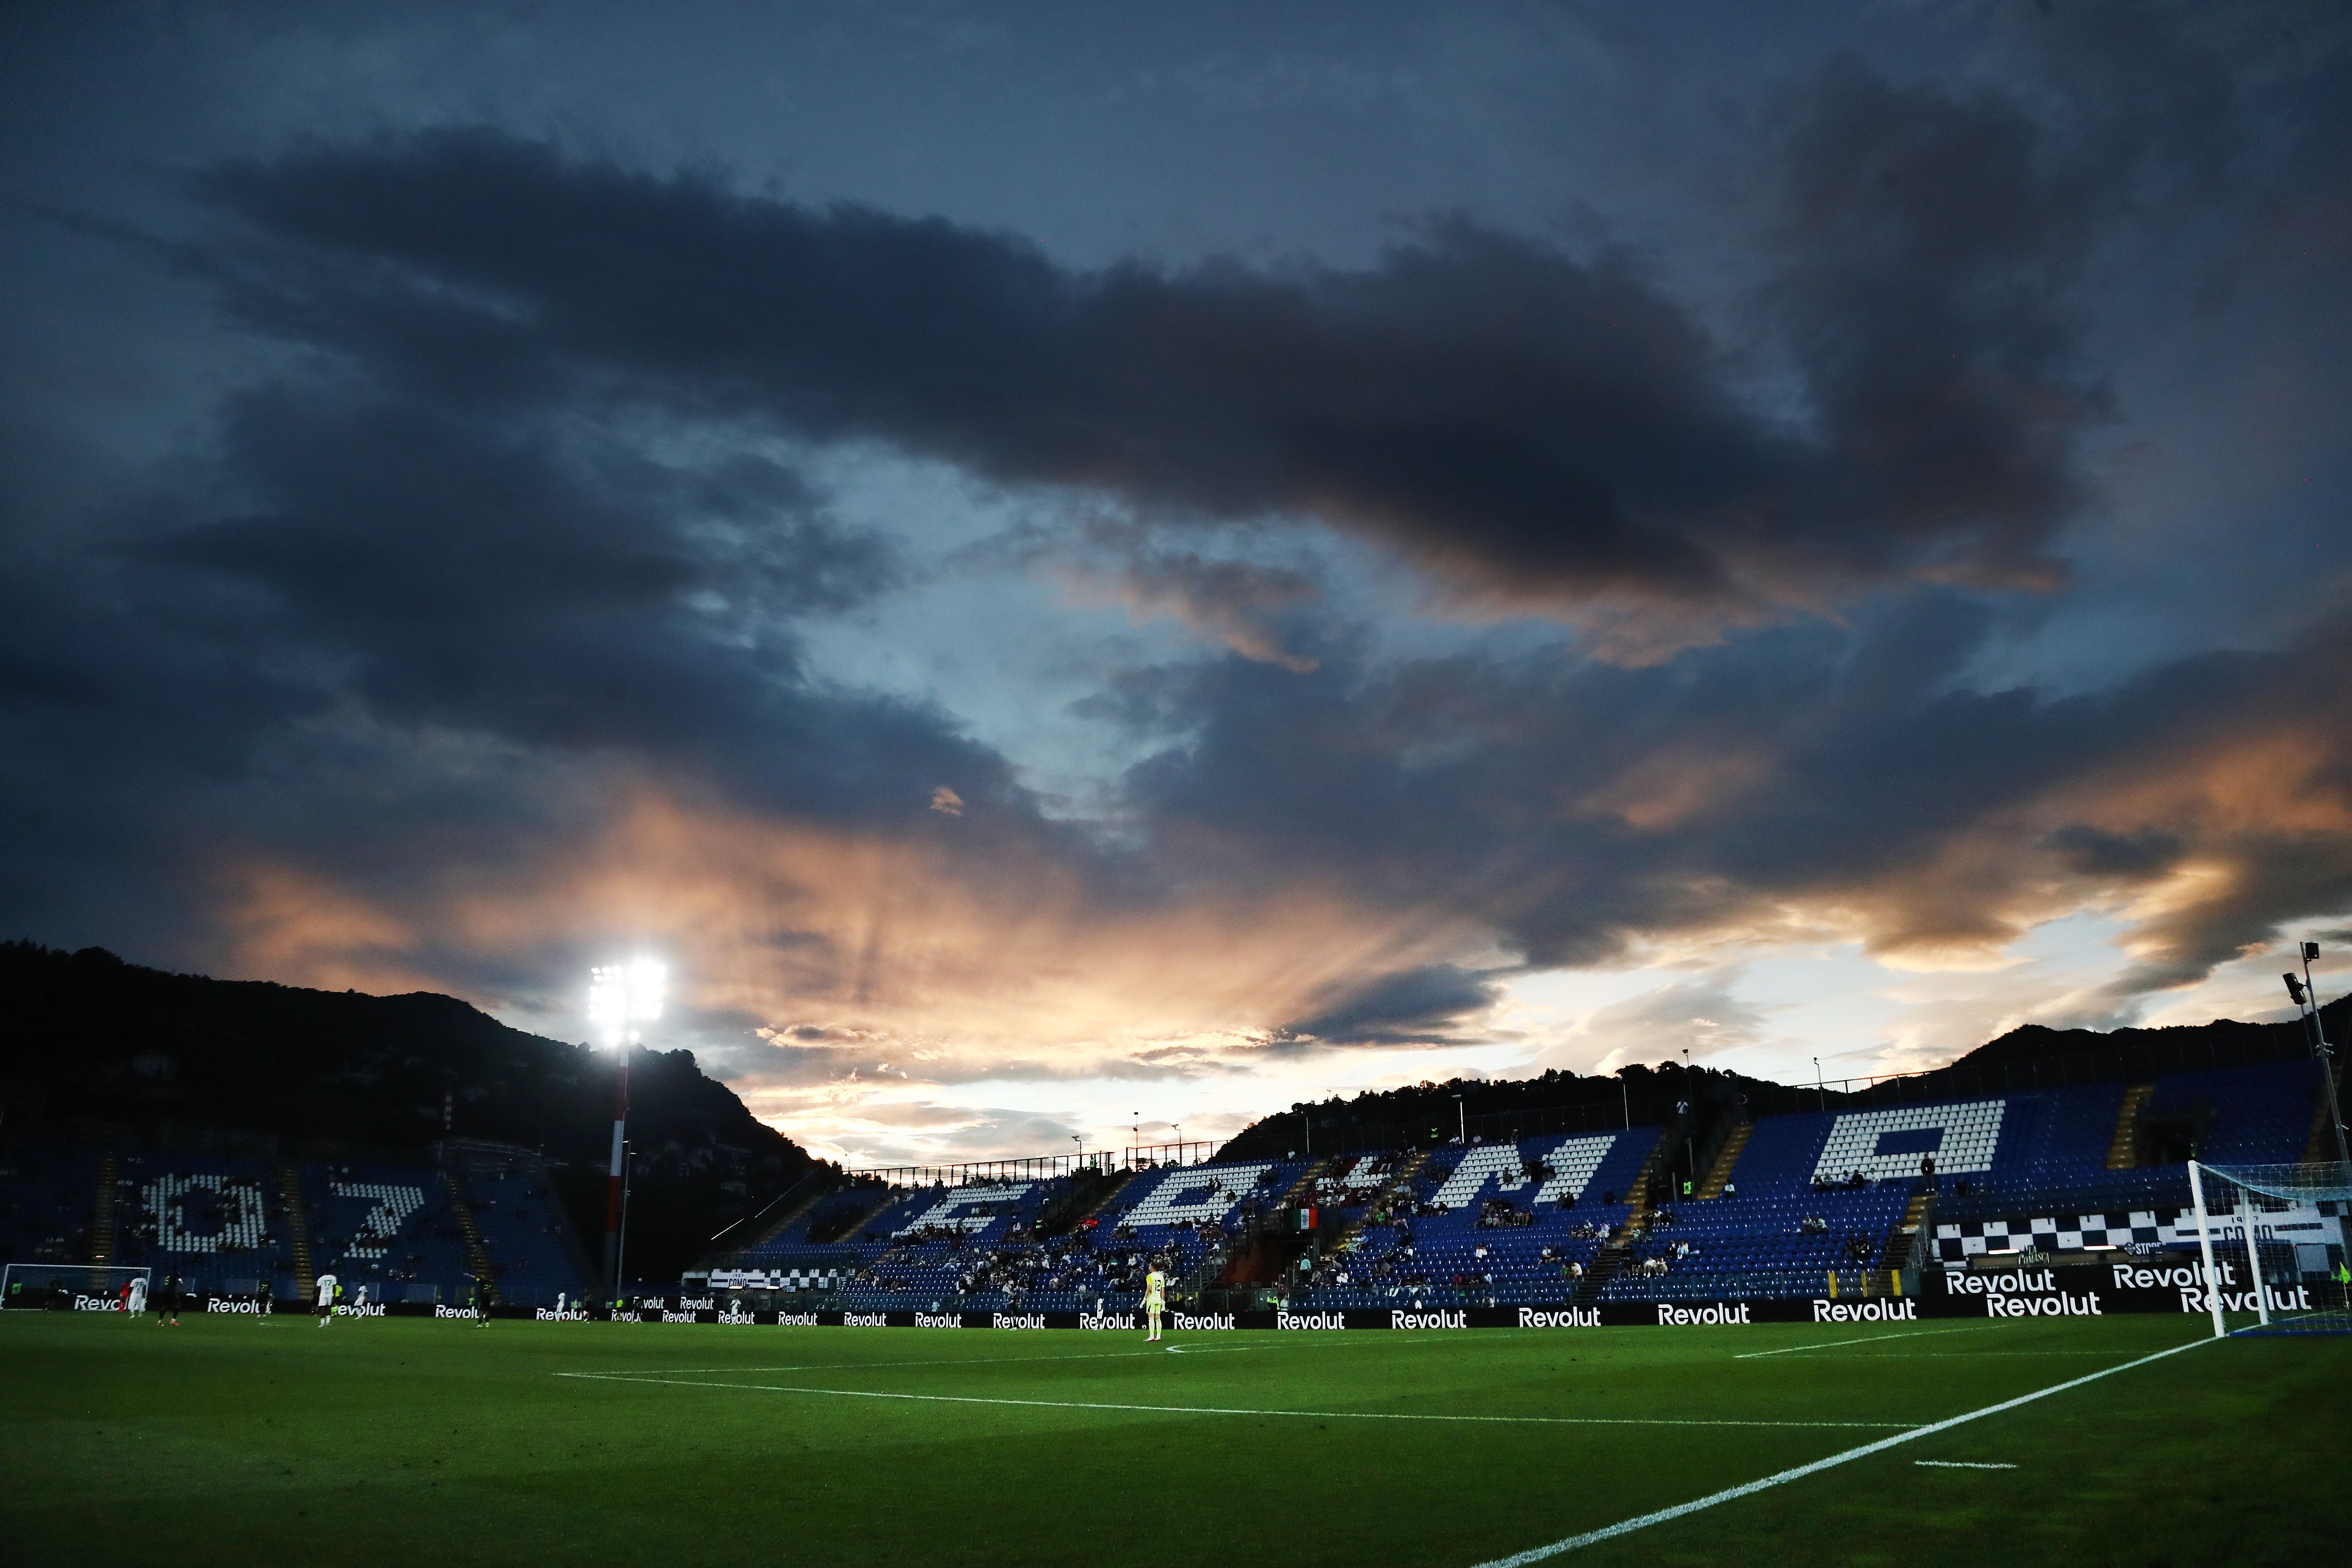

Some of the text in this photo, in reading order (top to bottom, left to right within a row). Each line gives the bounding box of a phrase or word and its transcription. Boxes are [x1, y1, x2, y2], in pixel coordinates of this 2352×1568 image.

[2231, 1215, 2258, 1224] 197
[1155, 1279, 1161, 1291] 12
[1946, 1268, 2056, 1295] Revolut
[337, 1302, 386, 1316] evolut
[680, 1296, 714, 1310] Revolut
[1813, 1297, 1917, 1322] Revolut
[1986, 1291, 2102, 1317] Revolut
[662, 1309, 696, 1323] Revolut
[778, 1311, 818, 1326] Revolut
[844, 1312, 886, 1326] Revolut
[916, 1312, 962, 1328] Revolut
[993, 1313, 1045, 1329] Revolut
[1174, 1312, 1235, 1329] Revolut
[1277, 1311, 1345, 1329] Revolut
[1392, 1309, 1467, 1329] Revolut
[1519, 1306, 1601, 1327] Revolut
[1658, 1303, 1750, 1325] Revolut
